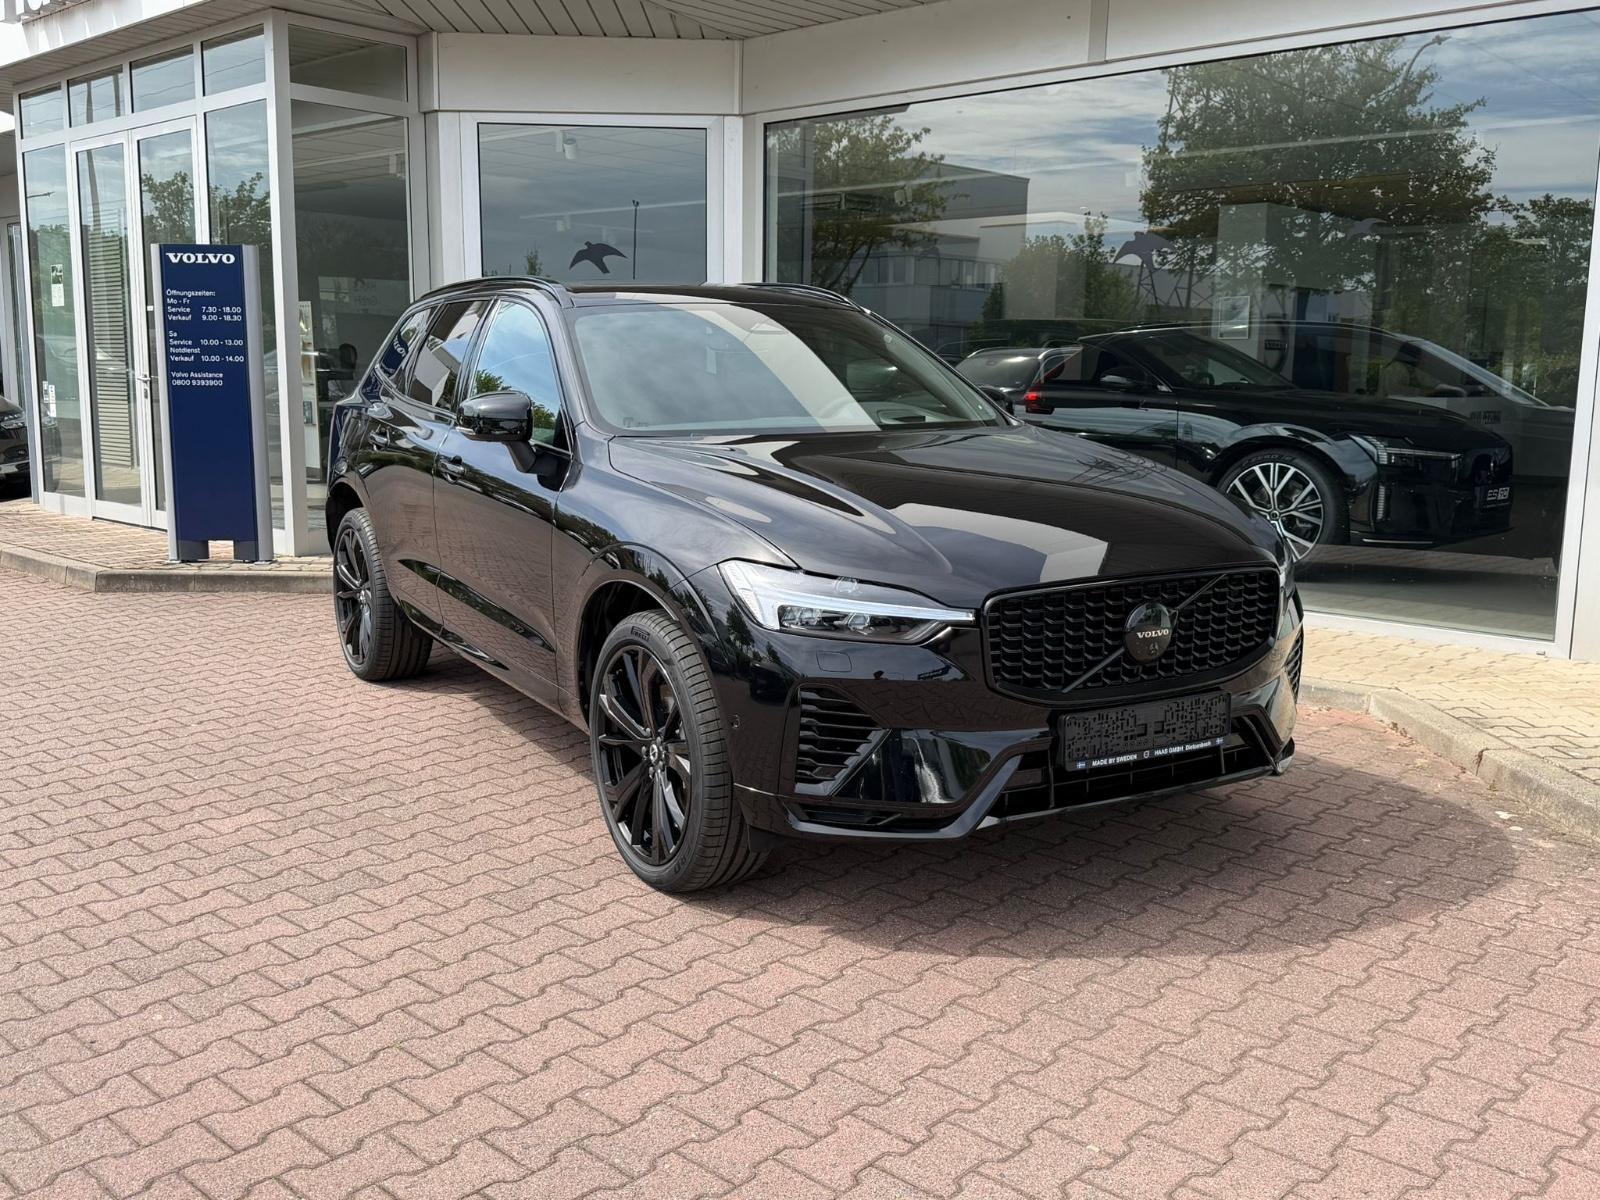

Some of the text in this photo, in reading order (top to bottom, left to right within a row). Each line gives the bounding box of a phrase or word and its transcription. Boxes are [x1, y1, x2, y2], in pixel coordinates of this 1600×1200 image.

[165, 252, 236, 264] VOLVO
[166, 288, 216, 298] Öffnungszeiten:
[1136, 628, 1169, 639] VOLVO
[1154, 747, 1168, 756] HAAS
[1092, 753, 1138, 767] MADE BY SWEDEN
